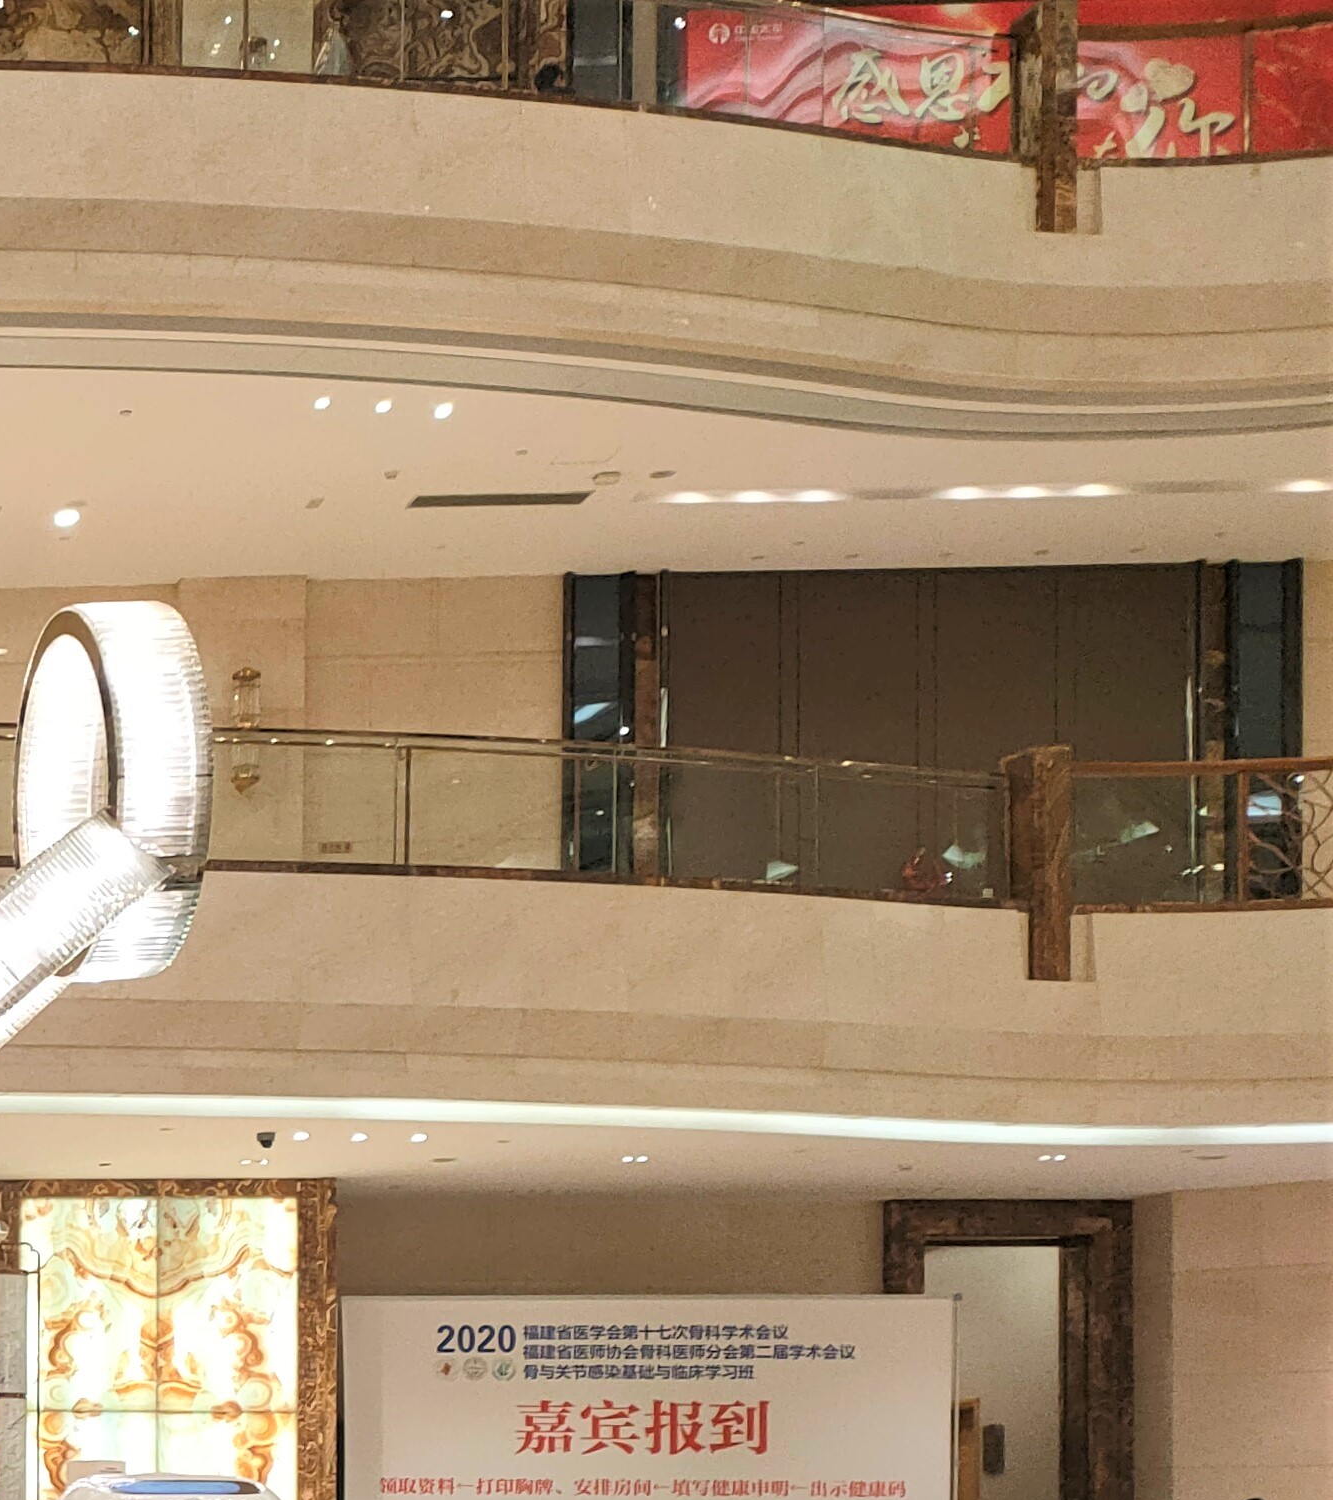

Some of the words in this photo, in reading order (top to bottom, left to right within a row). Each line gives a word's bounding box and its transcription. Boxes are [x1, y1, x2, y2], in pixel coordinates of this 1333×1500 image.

[436, 1325, 516, 1353] 2020
[523, 1325, 789, 1340] 福建省医学会第十七次骨科学术会议
[523, 1344, 856, 1360] 福建省医师协会骨科医师分会第二届学术会议
[523, 1364, 755, 1380] 骨与关节感染基础与临床学习班
[514, 1399, 771, 1456] 嘉宾报到
